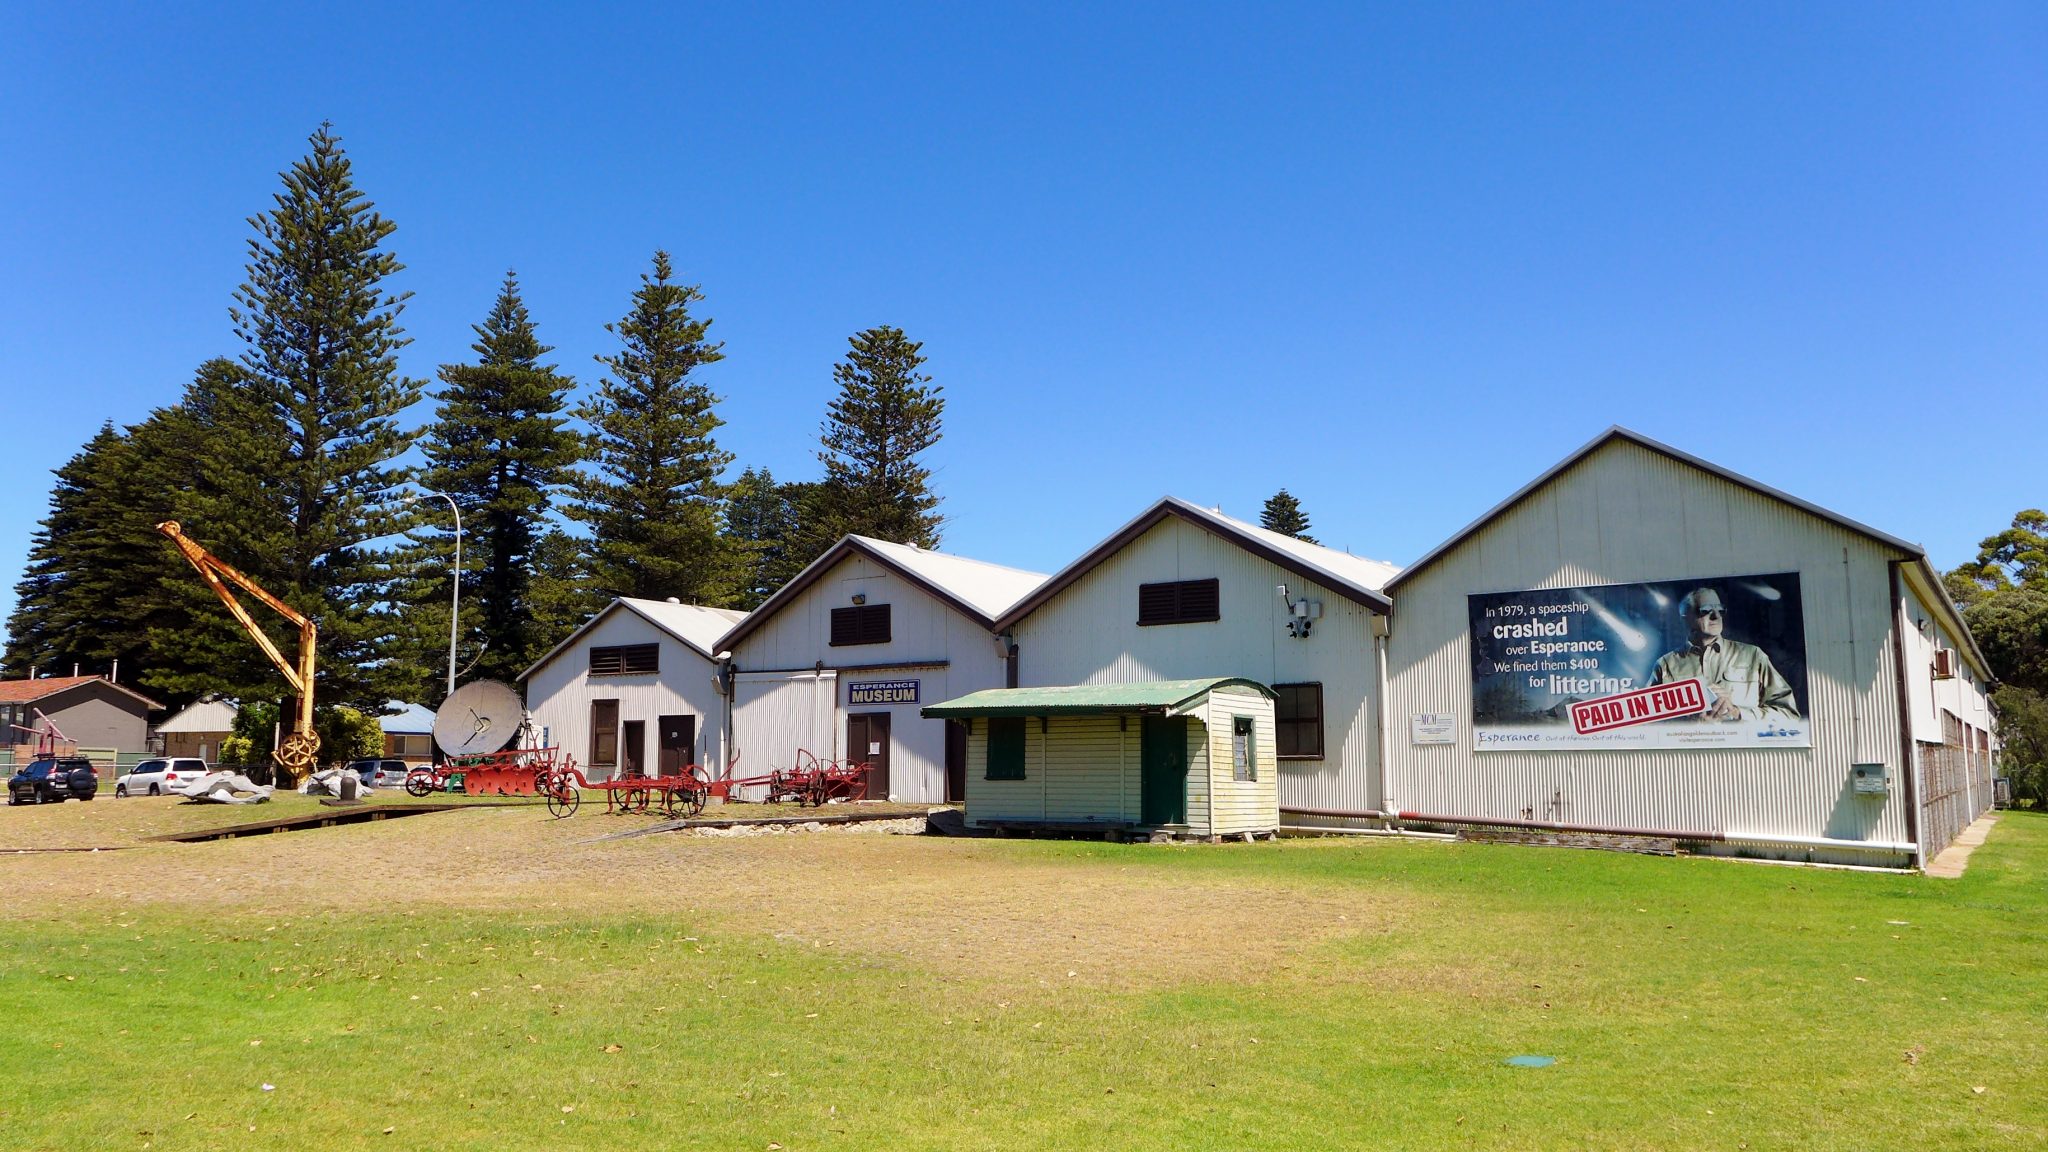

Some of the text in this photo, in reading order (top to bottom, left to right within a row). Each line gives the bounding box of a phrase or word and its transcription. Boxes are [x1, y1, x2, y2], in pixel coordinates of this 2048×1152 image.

[1486, 601, 1589, 618] In 1979, a spaceship
[1493, 616, 1568, 639] crashed
[1506, 640, 1608, 657] over Esperance.
[1494, 658, 1599, 673] We fined them $400
[852, 682, 916, 690] ESPERANCE
[1529, 674, 1639, 695] for littering.
[852, 688, 916, 703] MUSEUM
[1577, 686, 1699, 729] PAID IN FULL
[1478, 731, 1541, 746] Esperance
